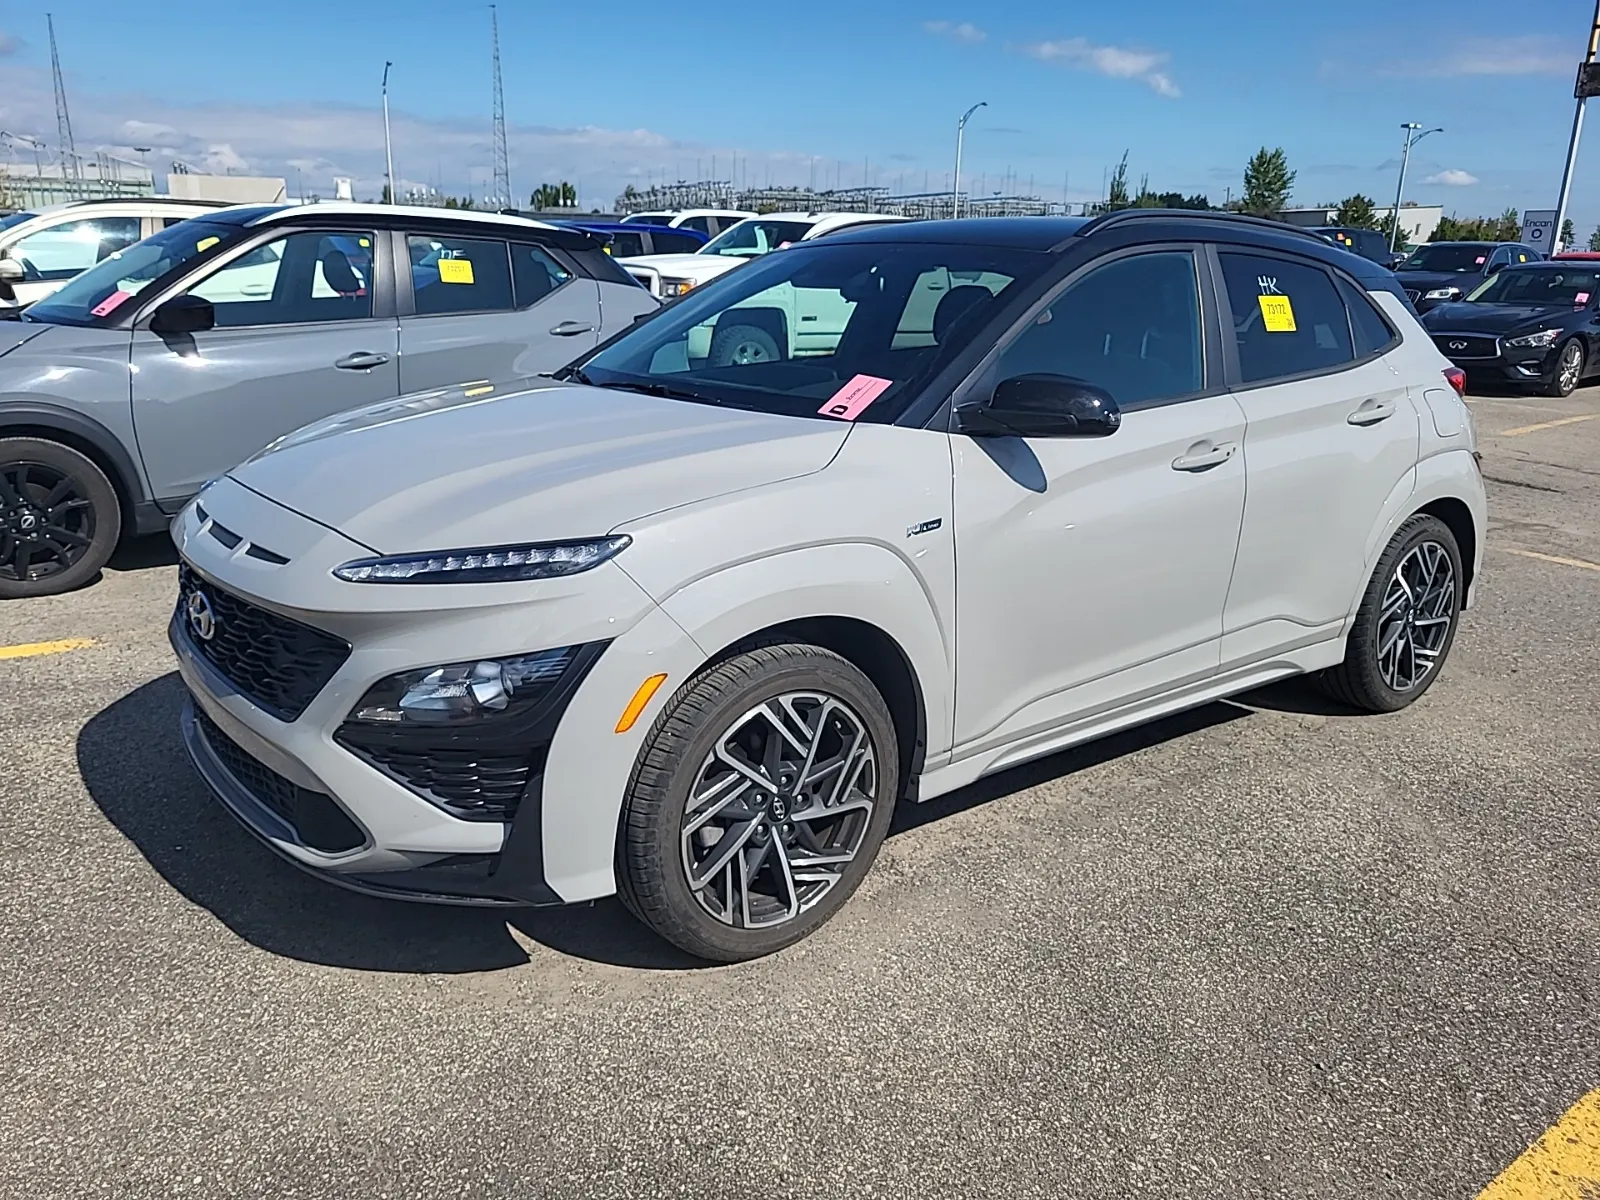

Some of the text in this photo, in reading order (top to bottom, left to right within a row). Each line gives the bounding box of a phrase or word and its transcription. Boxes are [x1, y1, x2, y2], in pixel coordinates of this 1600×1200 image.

[1524, 219, 1552, 228] Encan
[1257, 275, 1283, 295] HK
[1266, 303, 1287, 315] 73172
[828, 404, 849, 416] D
